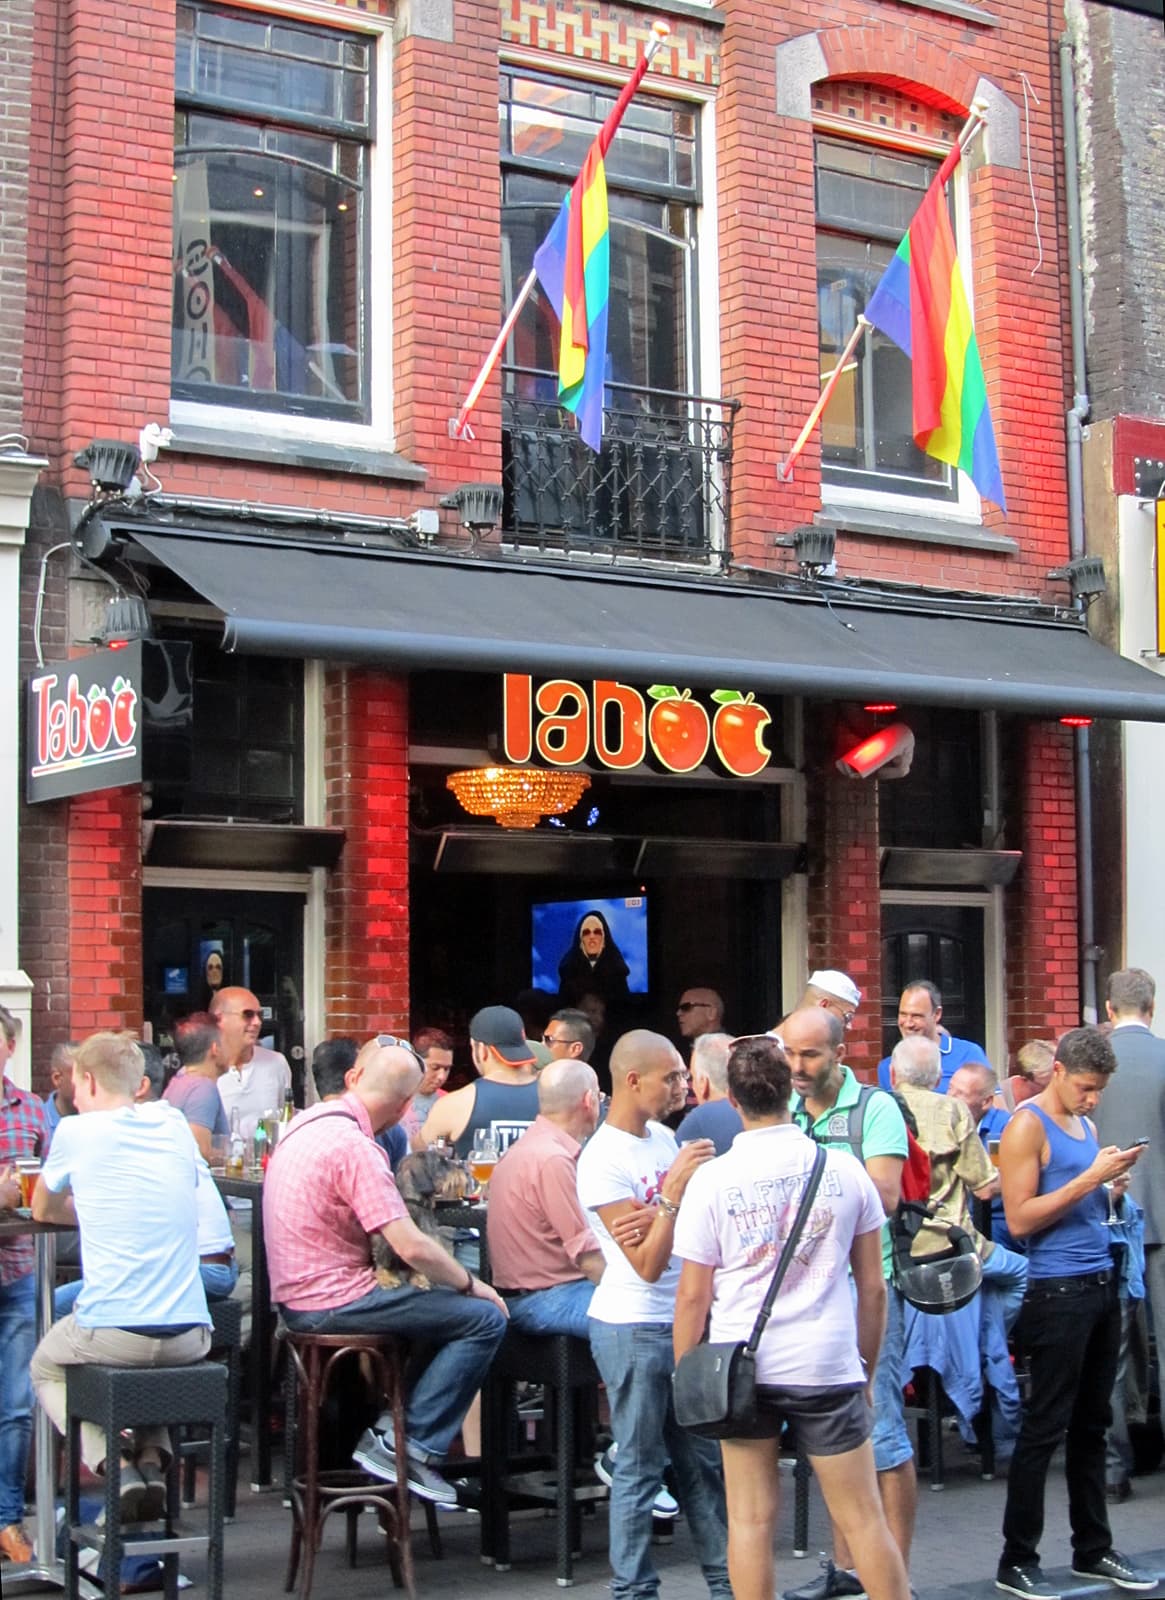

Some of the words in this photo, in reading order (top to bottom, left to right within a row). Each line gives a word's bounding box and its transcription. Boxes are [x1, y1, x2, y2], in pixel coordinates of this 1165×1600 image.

[32, 674, 137, 764] Taboo
[162, 1053, 181, 1069] 45
[738, 1226, 774, 1248] NEW
